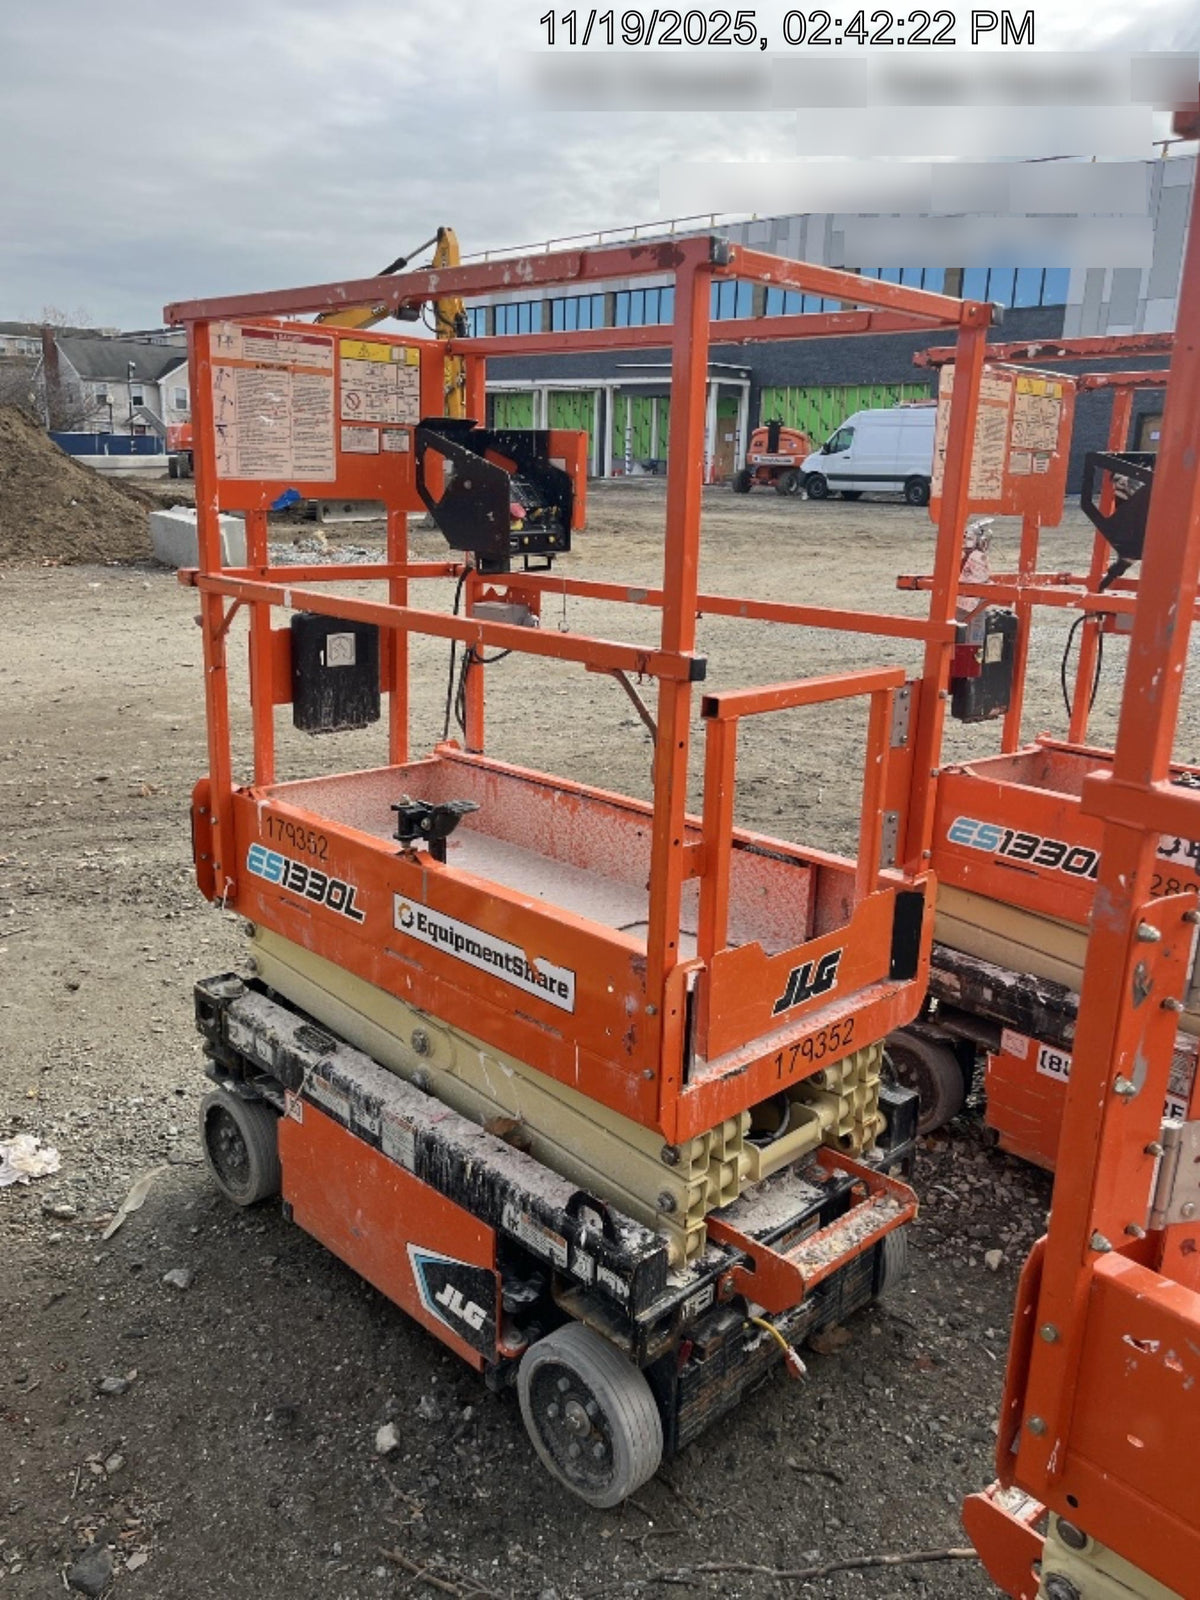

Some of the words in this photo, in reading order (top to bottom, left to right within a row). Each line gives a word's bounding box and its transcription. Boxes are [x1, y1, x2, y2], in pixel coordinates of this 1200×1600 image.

[266, 815, 329, 860] 179352
[247, 842, 366, 924] ES1330L
[771, 947, 843, 1017] JLG
[774, 1018, 855, 1080] 179352
[434, 1282, 488, 1331] JLG
